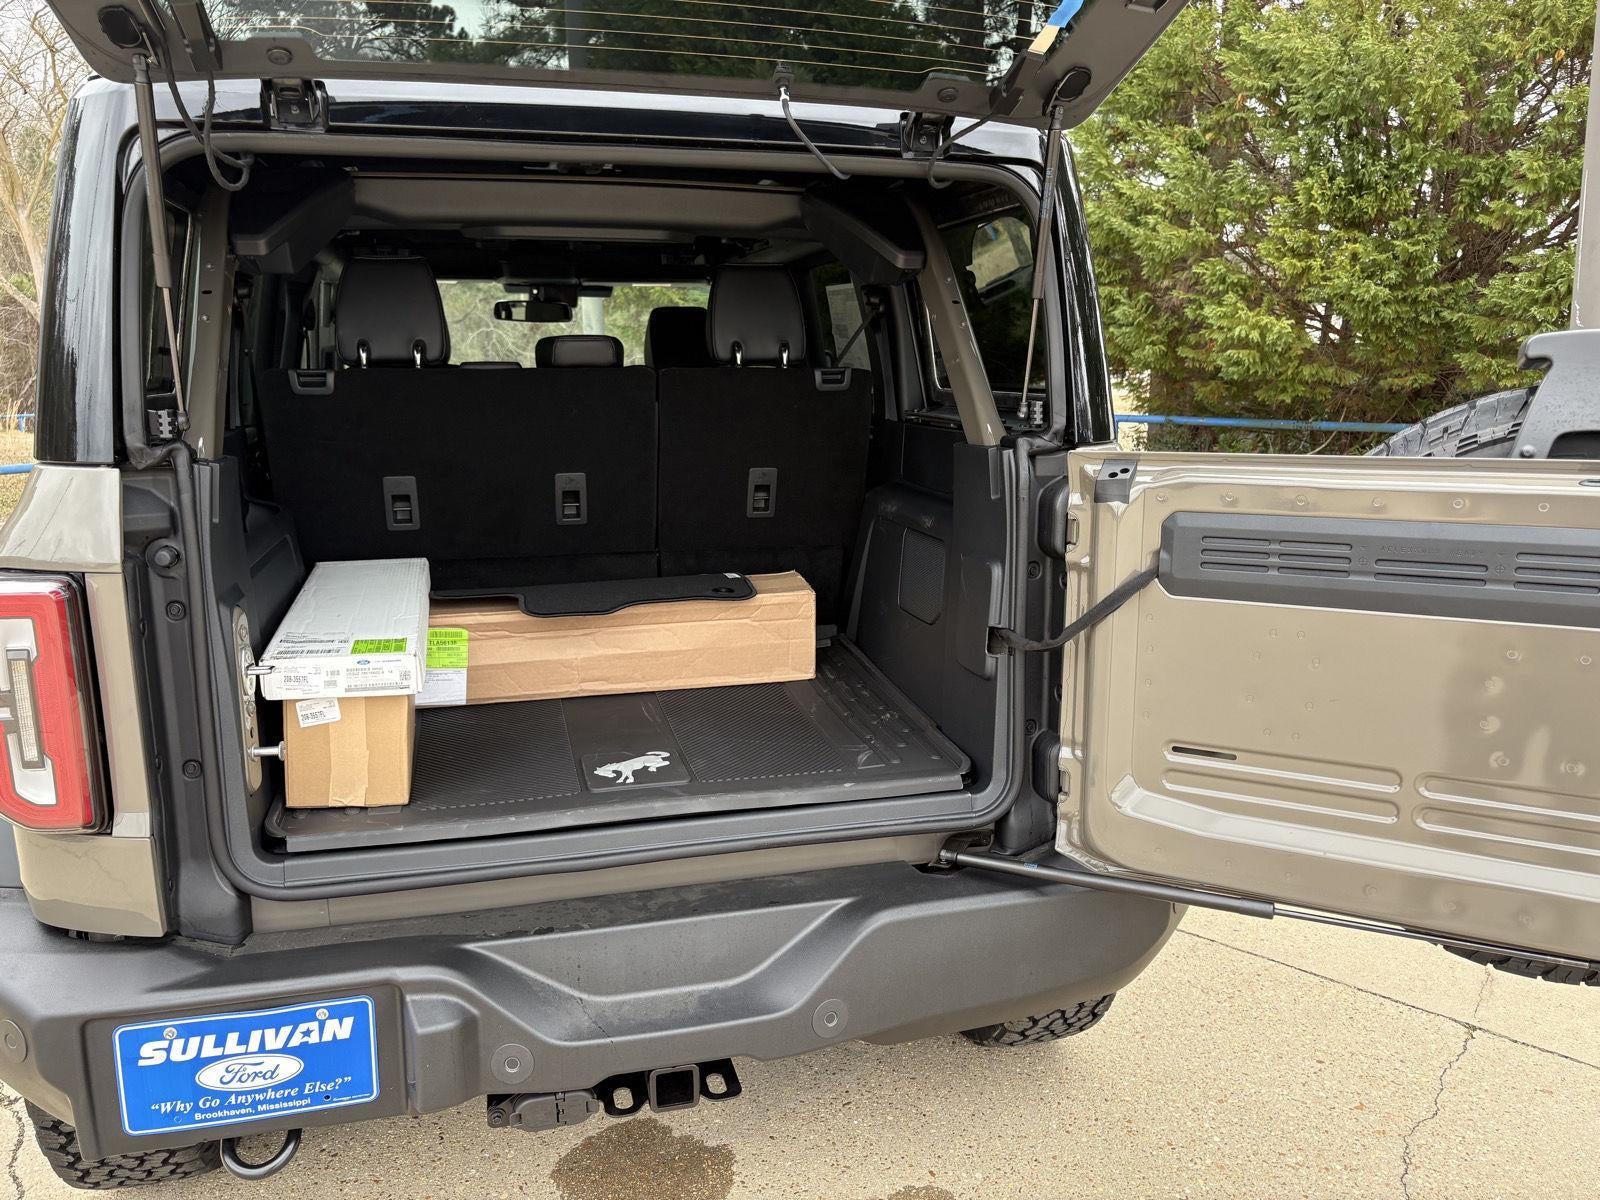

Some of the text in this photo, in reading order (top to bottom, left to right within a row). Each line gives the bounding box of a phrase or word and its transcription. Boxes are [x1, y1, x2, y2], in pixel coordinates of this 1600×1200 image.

[137, 1016, 355, 1067] SULLIVAN
[219, 1062, 281, 1086] Ford
[194, 1098, 311, 1120] Brookhaven, Mississippi
[198, 1096, 220, 1109] Go
[225, 1087, 299, 1107] Anywhere
